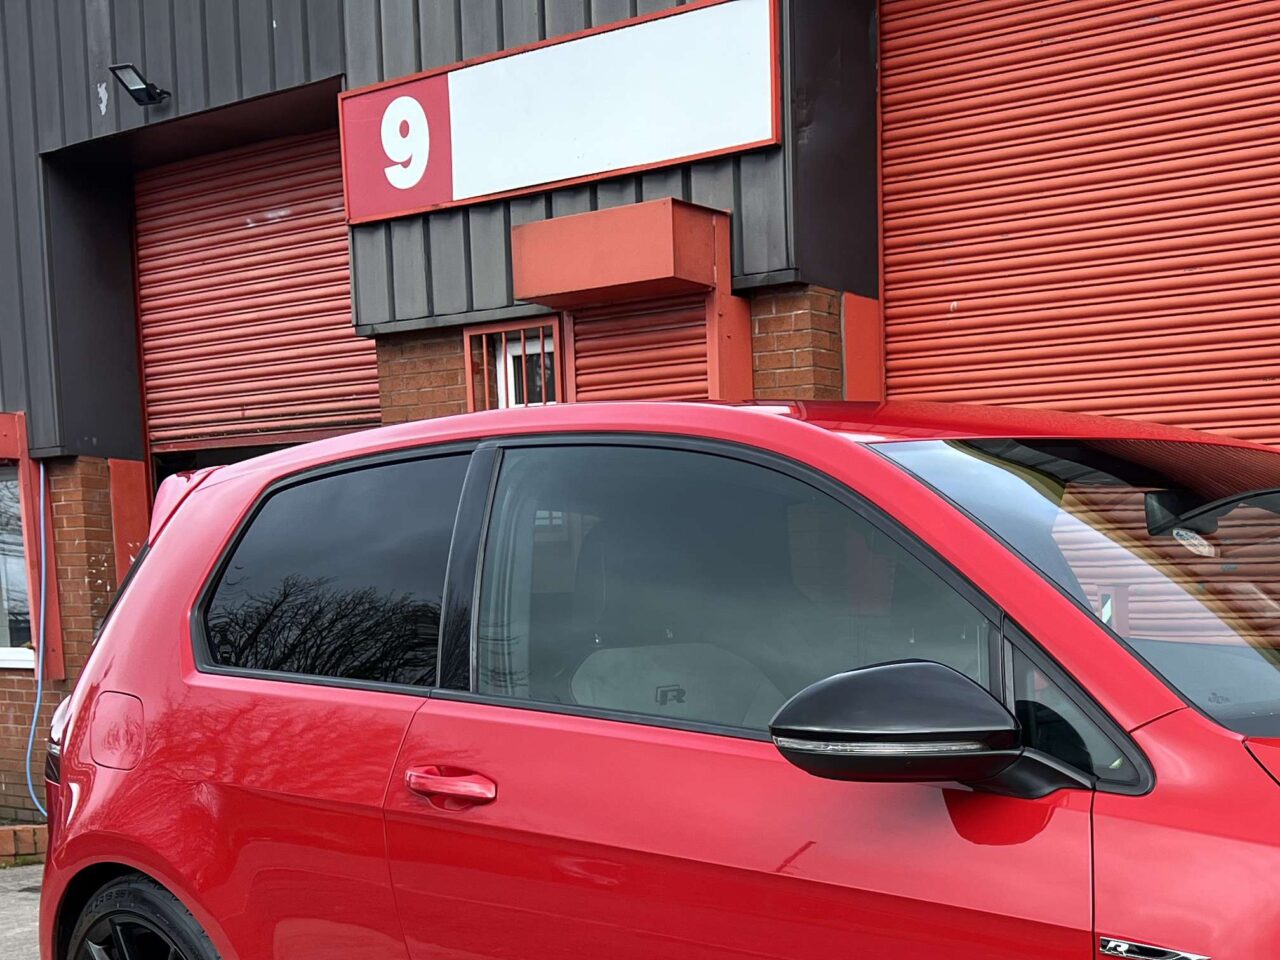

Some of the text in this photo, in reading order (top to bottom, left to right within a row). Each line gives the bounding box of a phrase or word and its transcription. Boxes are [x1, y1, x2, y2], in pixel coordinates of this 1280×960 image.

[381, 95, 430, 190] 9
[655, 684, 686, 706] R
[1106, 940, 1130, 957] R
